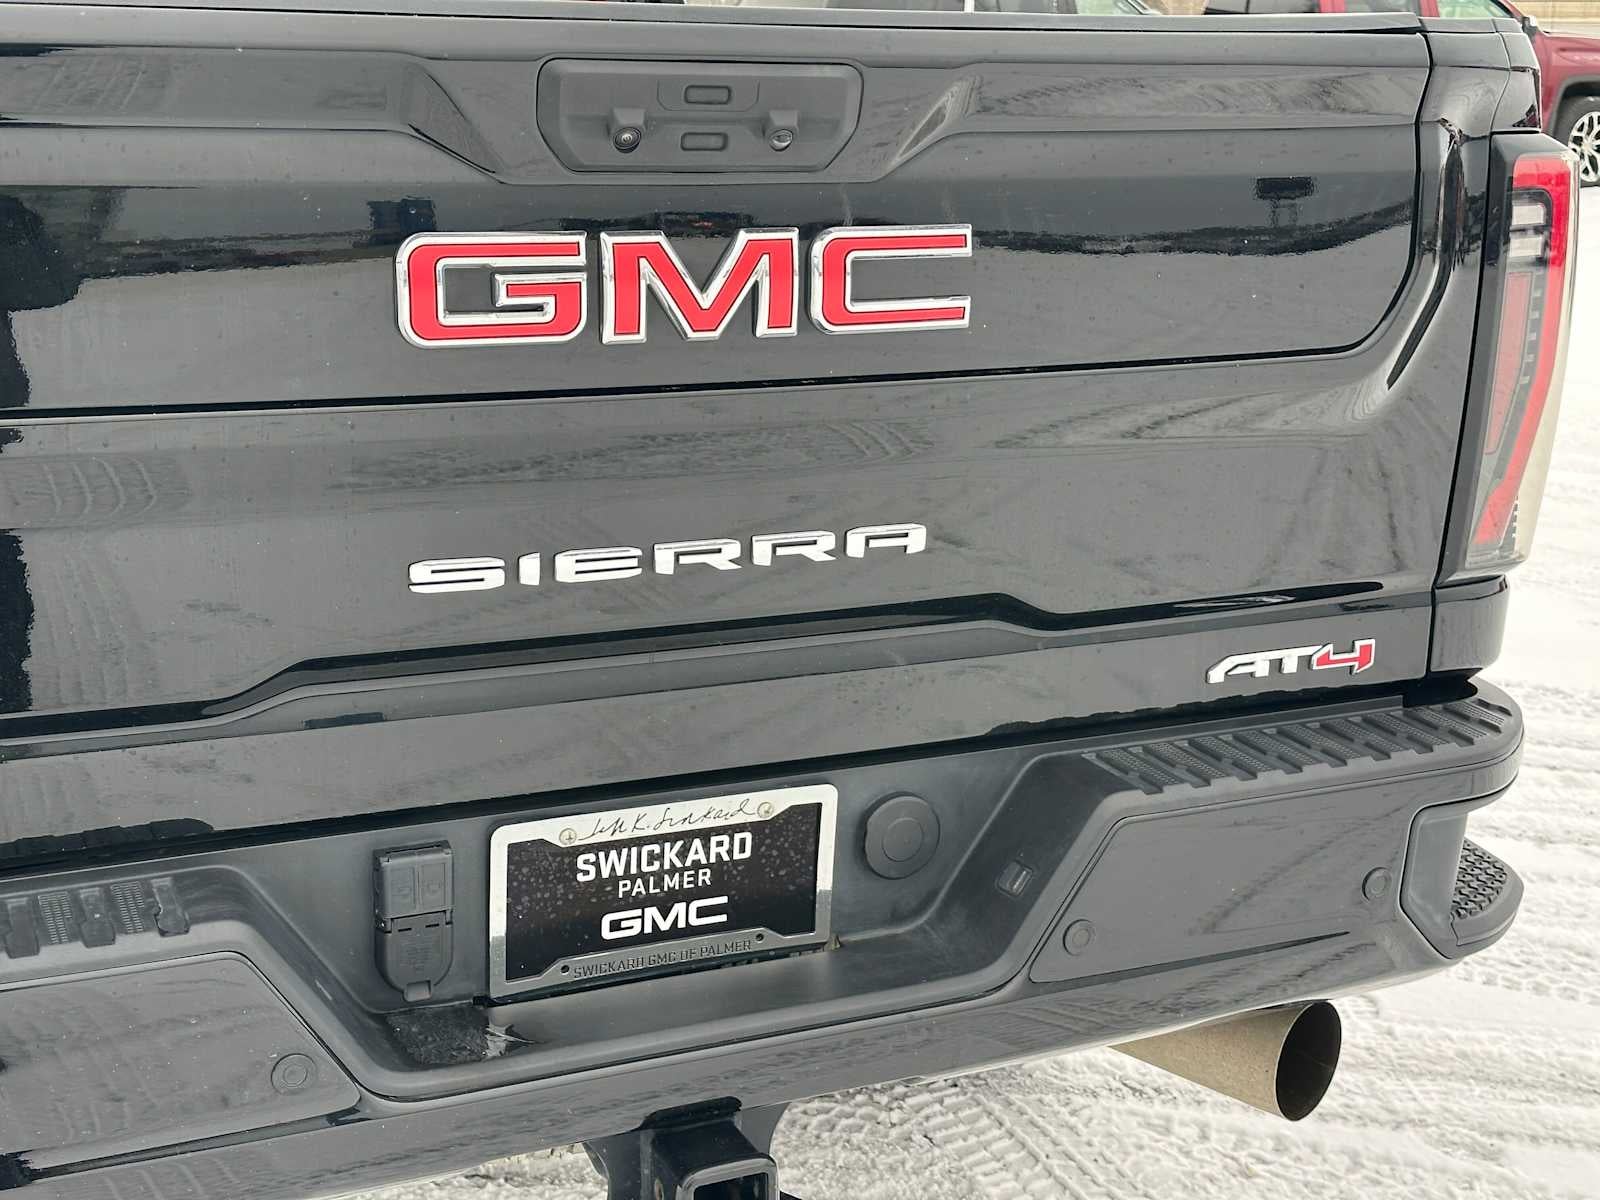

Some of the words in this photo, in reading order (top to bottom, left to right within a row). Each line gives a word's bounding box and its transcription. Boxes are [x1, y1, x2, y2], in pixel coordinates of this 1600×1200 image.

[396, 223, 974, 349] GMC
[408, 523, 928, 595] SIERRA
[1206, 638, 1376, 684] AT4
[576, 832, 753, 882] SWICKARD
[617, 867, 712, 898] PALMER
[601, 896, 729, 940] GMC
[574, 957, 645, 978] SWICKARD
[648, 951, 677, 967] GMC
[680, 949, 697, 962] OF
[700, 940, 752, 958] PALMER
